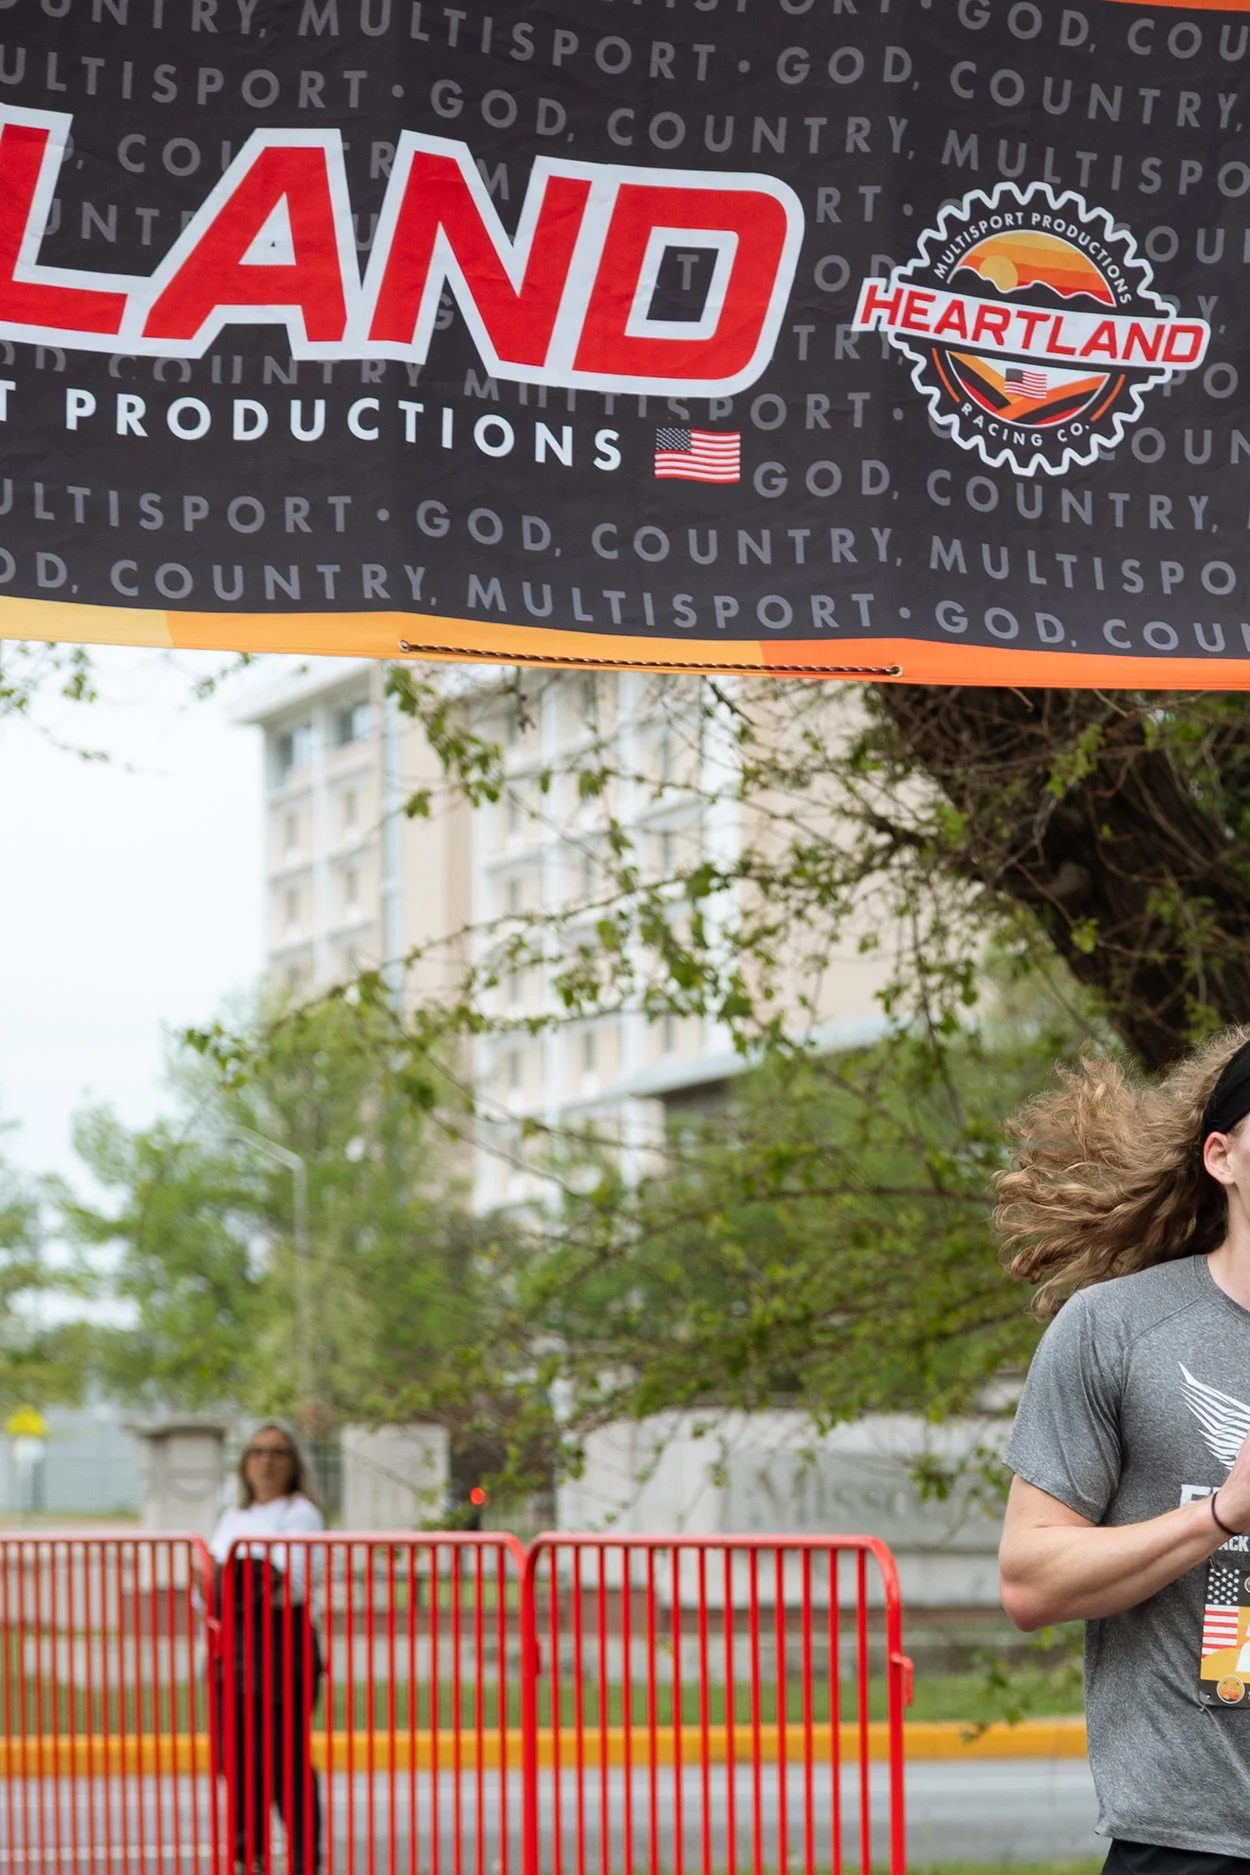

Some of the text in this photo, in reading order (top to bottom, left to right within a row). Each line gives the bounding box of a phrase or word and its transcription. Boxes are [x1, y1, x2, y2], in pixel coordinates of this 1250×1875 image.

[298, 0, 716, 82] MULTISPORT
[776, 46, 920, 91] GOD,
[950, 61, 1243, 132] COUNTRY,
[958, 0, 1096, 53] GOD,
[431, 79, 575, 142] GOD,
[607, 108, 914, 160] COUNTRY,
[0, 105, 804, 397] LAND
[933, 211, 1132, 304] MULTISPORT PRODUCTIONS
[860, 283, 1205, 365] HEARTLAND
[65, 387, 622, 471] PRODUCTIONS
[960, 403, 1043, 447] RACING
[416, 500, 562, 557] GOD,
[592, 523, 902, 566] COUNTRY,
[753, 459, 899, 500] GOD,
[927, 469, 1219, 533] COUNTRY,
[110, 560, 437, 606] COUNTRY,
[467, 574, 875, 629] MULTISPORT
